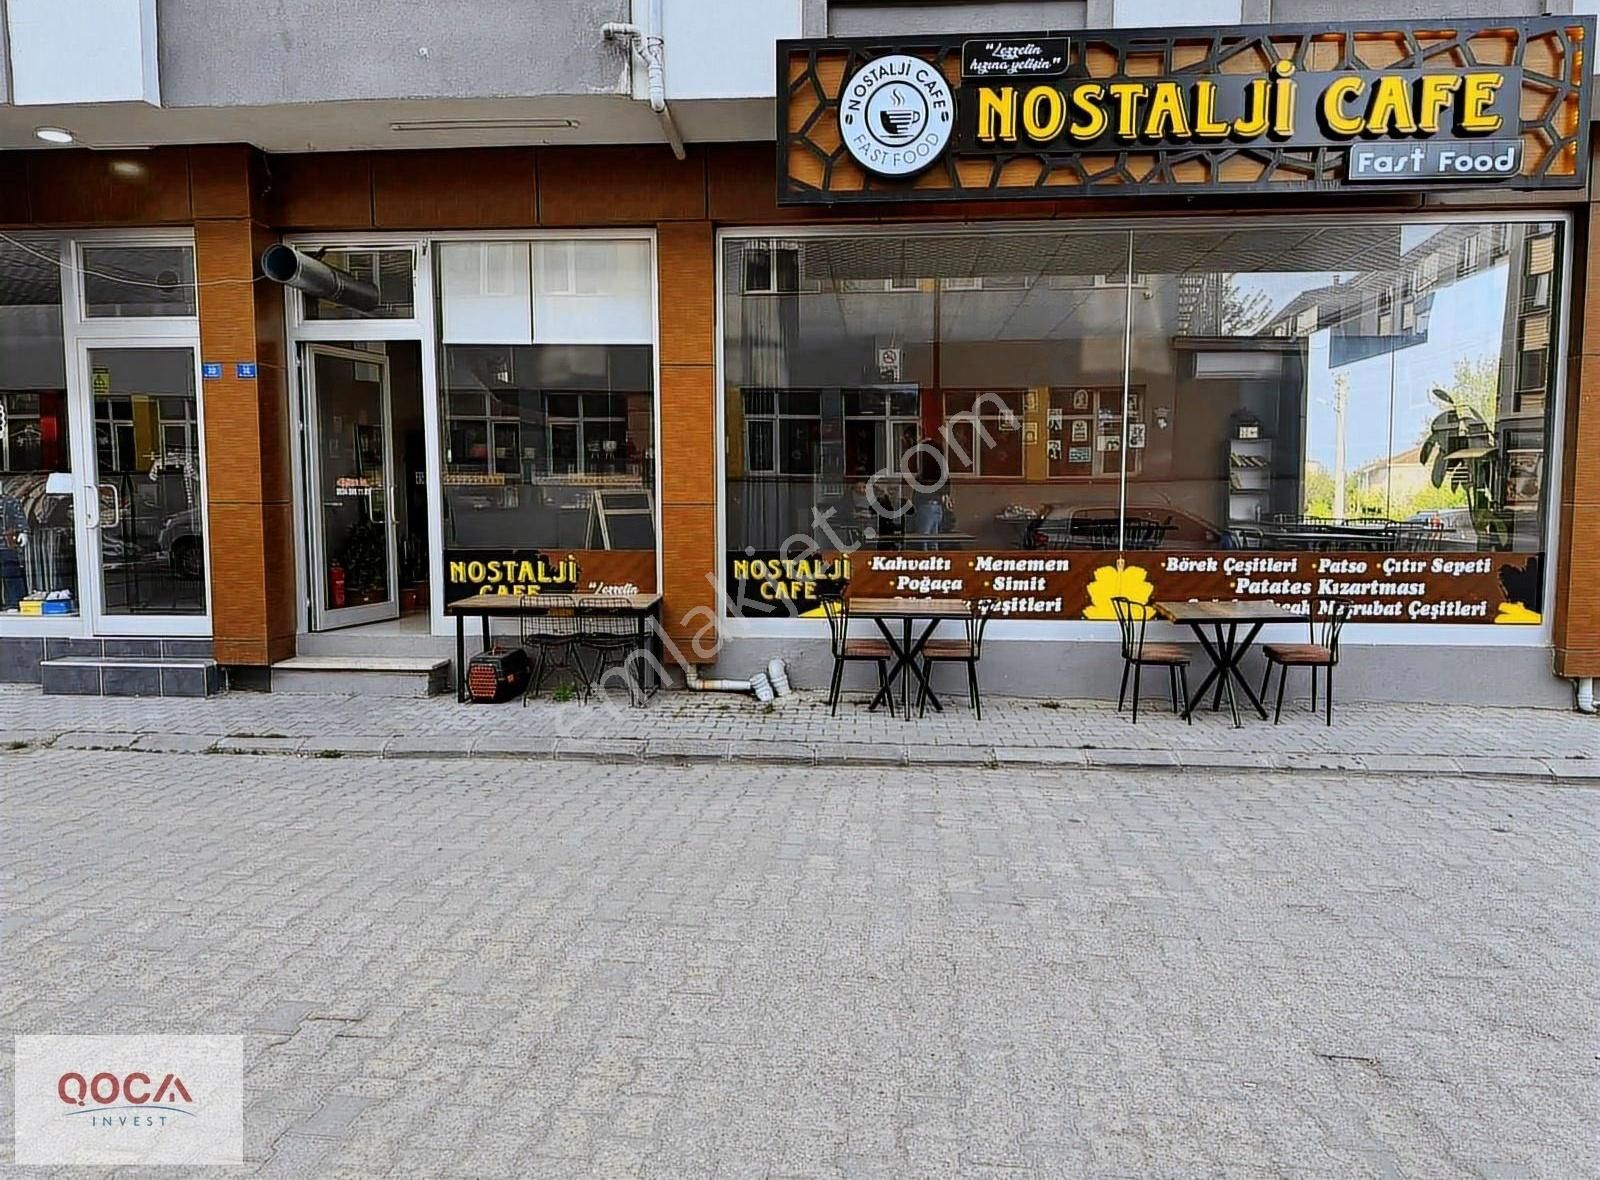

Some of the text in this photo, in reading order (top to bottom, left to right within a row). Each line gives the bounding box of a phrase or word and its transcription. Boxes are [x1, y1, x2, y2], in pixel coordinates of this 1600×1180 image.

[916, 70, 947, 109] CAFE
[1322, 73, 1504, 136] CAFE
[853, 132, 940, 167] FAST FOOD
[1358, 147, 1515, 173] Fast Food
[871, 556, 1069, 572] Kahvaltı Menemen
[1166, 556, 1492, 577] Börek Çeşitleri Patso Çıtır Sepeti
[760, 581, 818, 600] CAFE
[896, 575, 1047, 595] Poğaça Simit
[1235, 578, 1425, 596] Patates Kızartması
[1408, 601, 1487, 619] Çeşitleri
